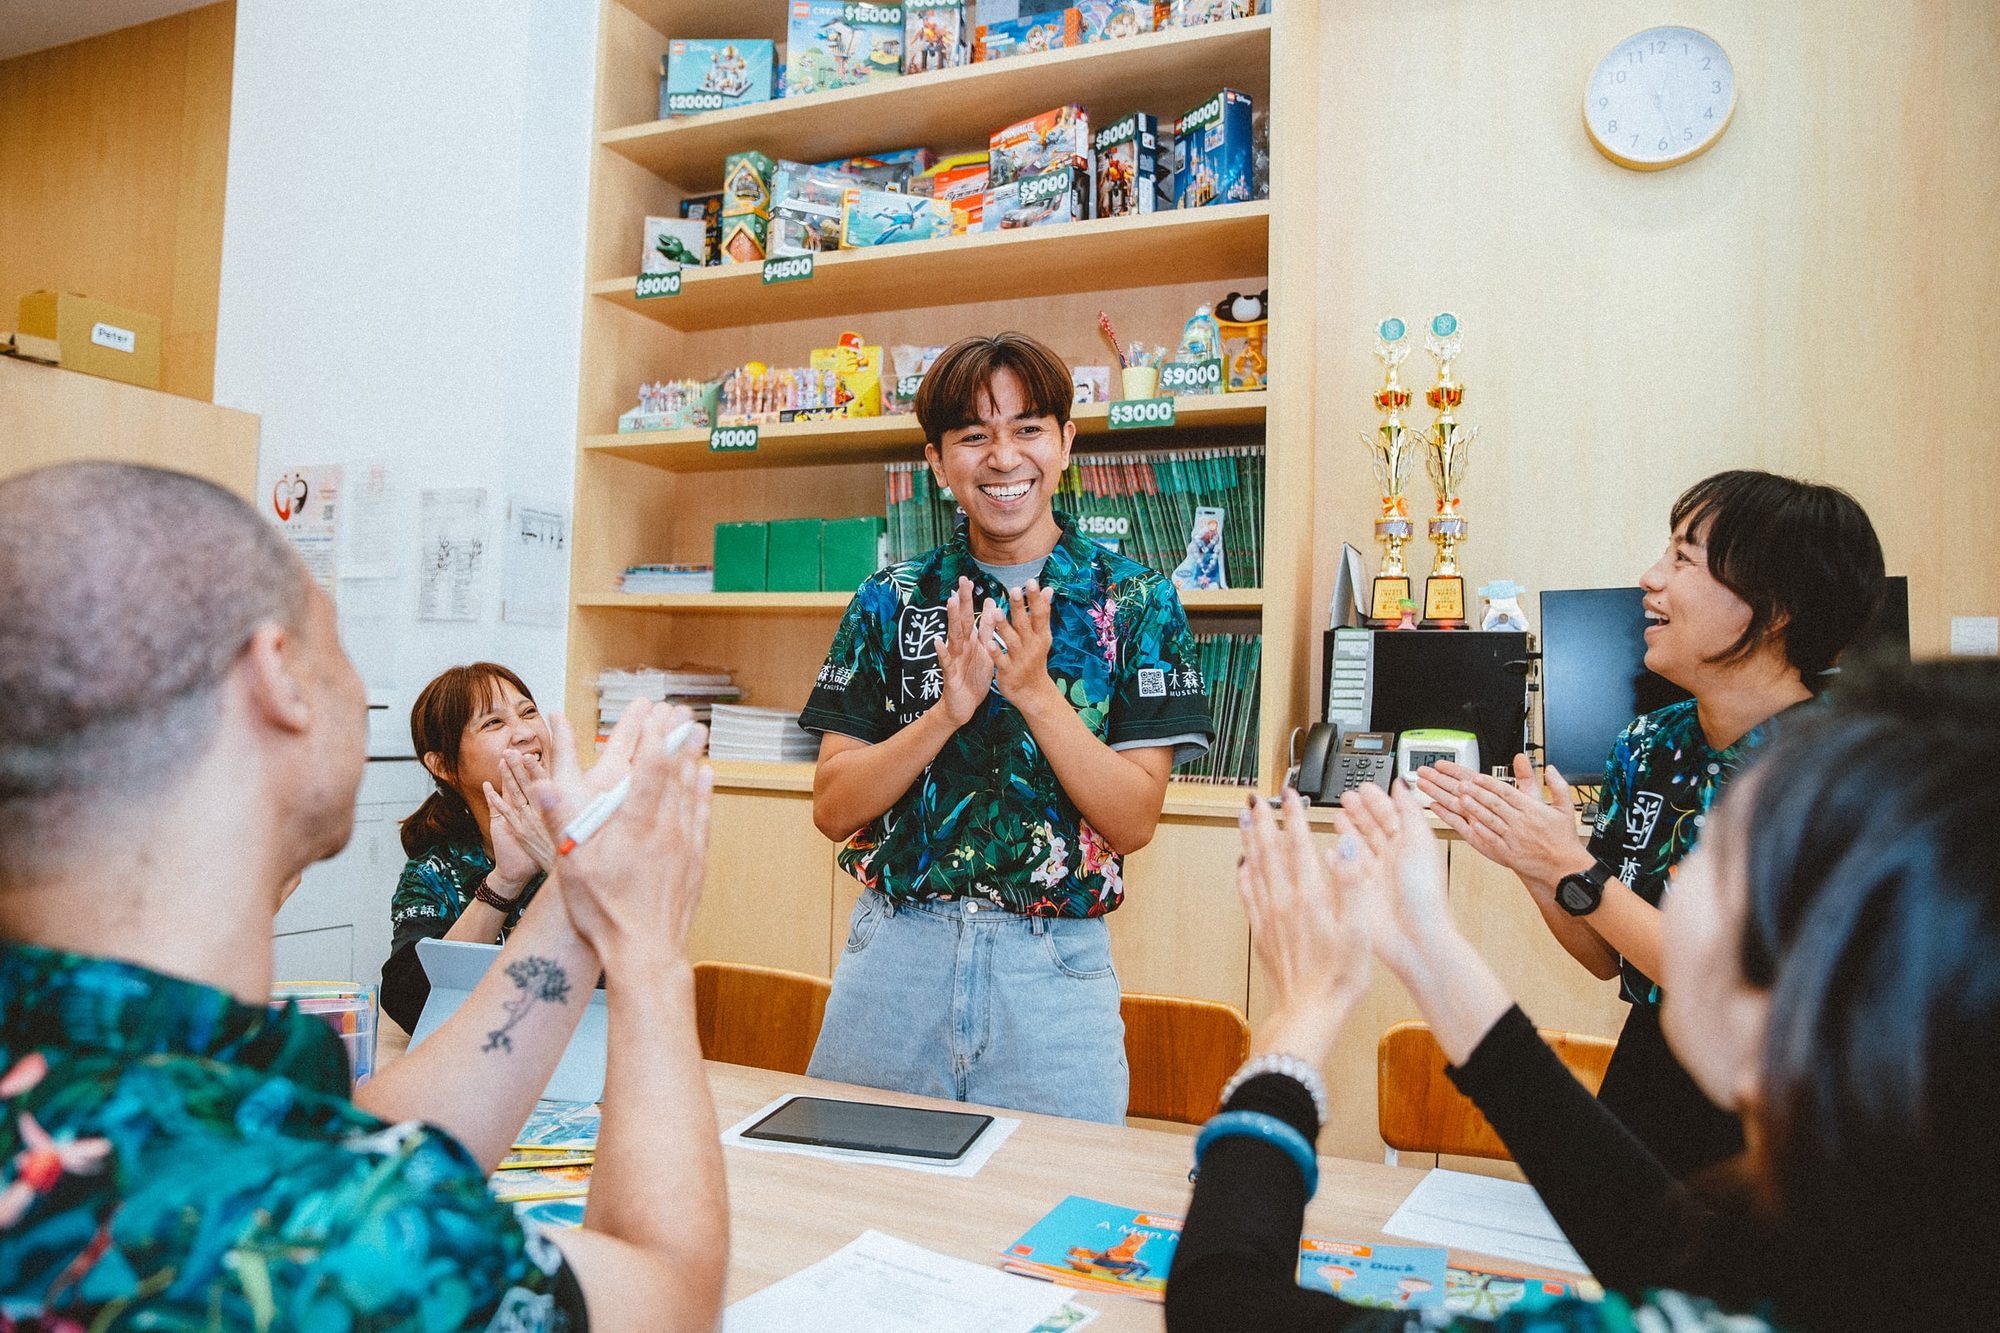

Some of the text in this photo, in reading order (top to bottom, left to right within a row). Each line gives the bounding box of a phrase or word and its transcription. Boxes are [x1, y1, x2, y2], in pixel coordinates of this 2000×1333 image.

[844, 5, 901, 23] $15000
[1649, 41, 1667, 55] 12
[1682, 43, 1688, 55] 1
[1627, 51, 1643, 64] 11
[1702, 57, 1711, 71] 2
[1609, 70, 1626, 84] 10
[1711, 80, 1722, 94] 3
[669, 94, 722, 111] $20000
[1598, 97, 1608, 111] 9
[1181, 99, 1219, 133] $18000
[1703, 106, 1713, 120] 4
[1608, 120, 1618, 133] 8
[1096, 118, 1135, 150] $8000
[1630, 134, 1640, 148] 7
[1683, 127, 1693, 141] 5
[1658, 137, 1668, 151] 6
[1020, 172, 1069, 197] $9000
[764, 258, 812, 281] $4500
[636, 275, 680, 296] $9000
[1162, 363, 1220, 386] $9000
[897, 376, 925, 397] $5
[1110, 402, 1172, 425] $3000
[711, 429, 757, 450] $1000
[1077, 515, 1129, 535] $1500
[1169, 688, 1199, 697] MUSEN
